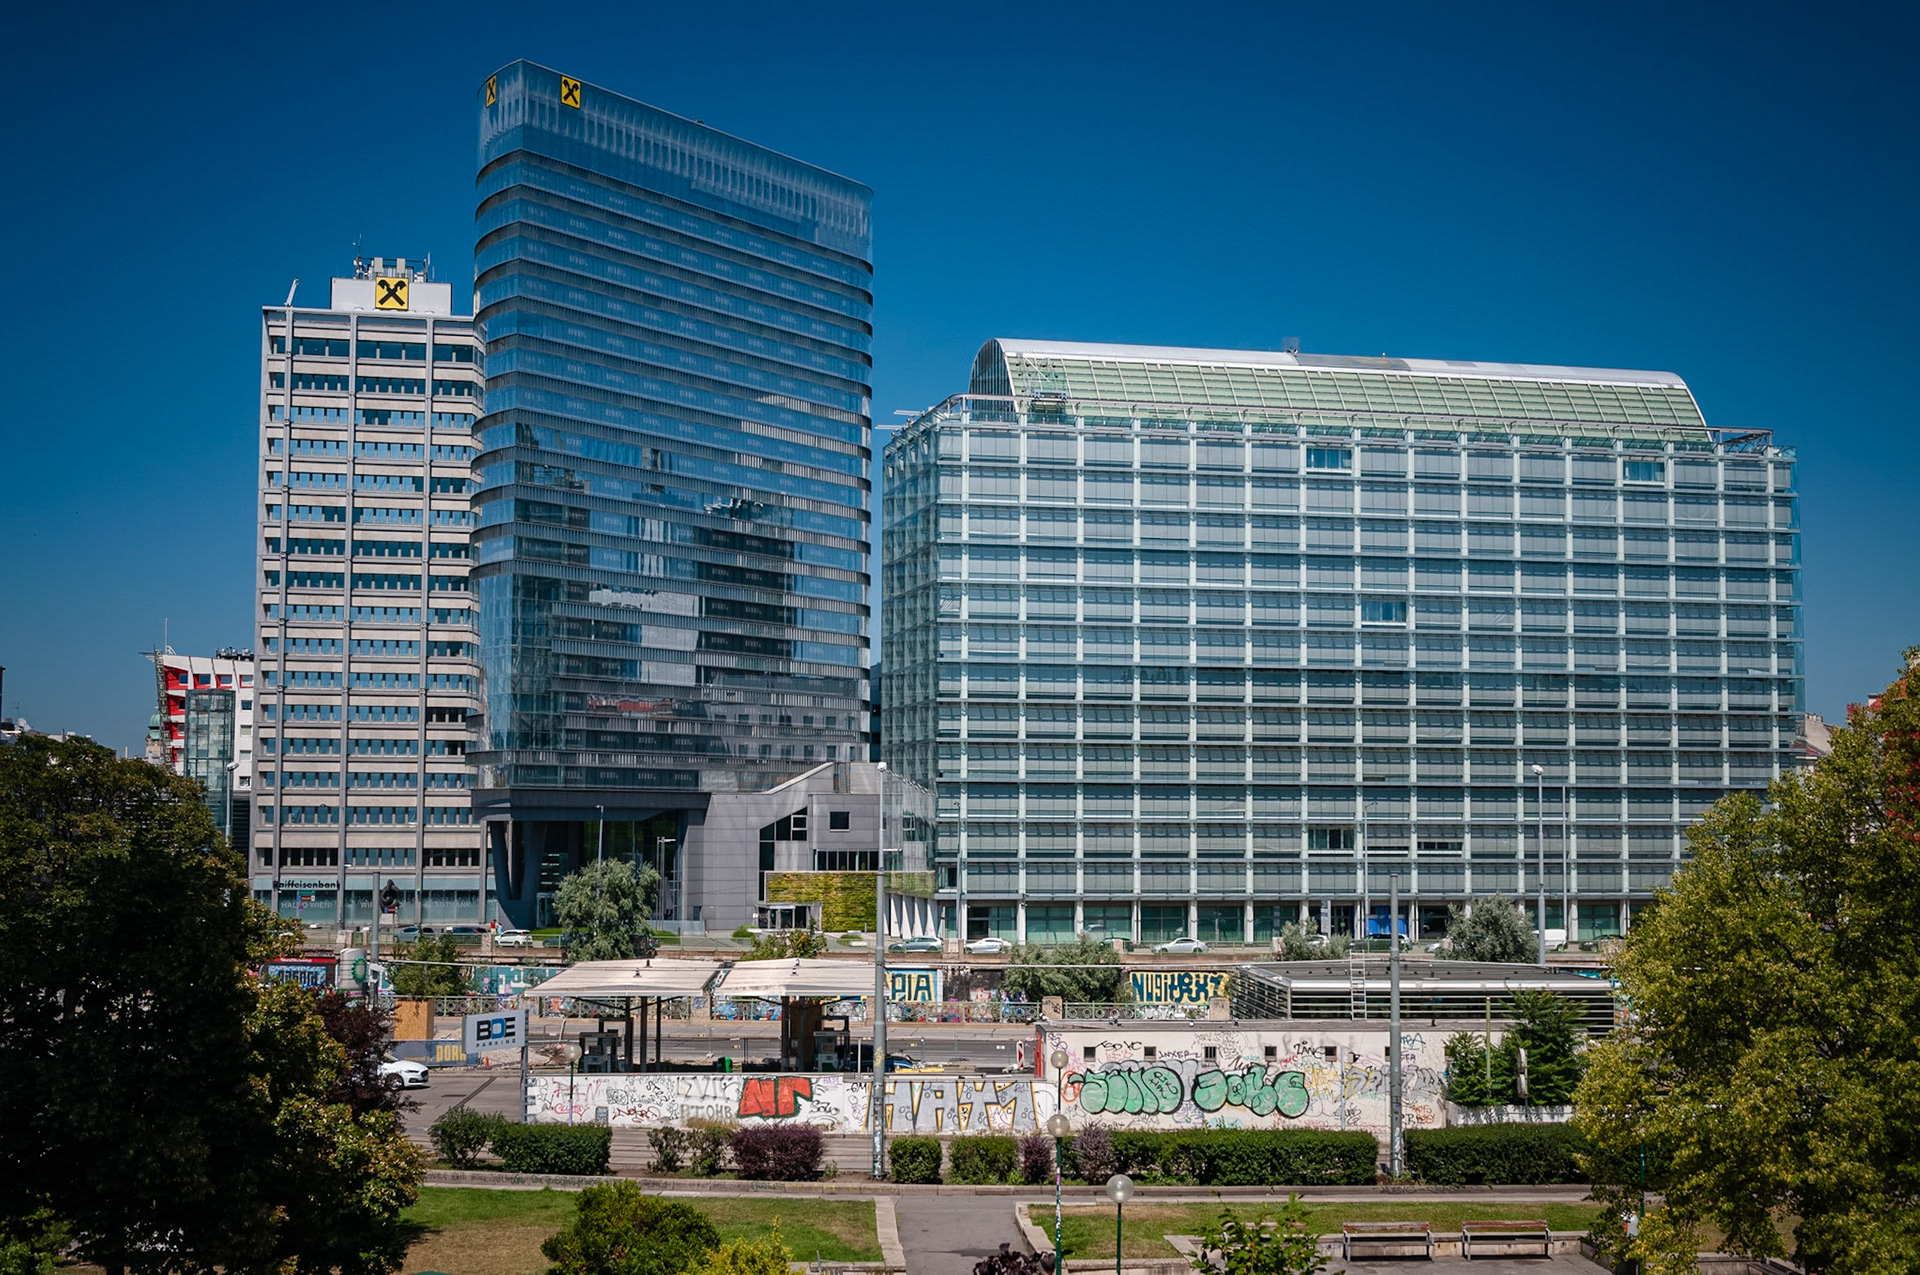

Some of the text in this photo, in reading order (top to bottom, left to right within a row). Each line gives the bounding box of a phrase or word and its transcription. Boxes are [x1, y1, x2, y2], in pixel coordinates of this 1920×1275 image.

[273, 880, 340, 890] Raiffeisenbank
[281, 901, 308, 909] HALO
[476, 1038, 516, 1048] PARKING
